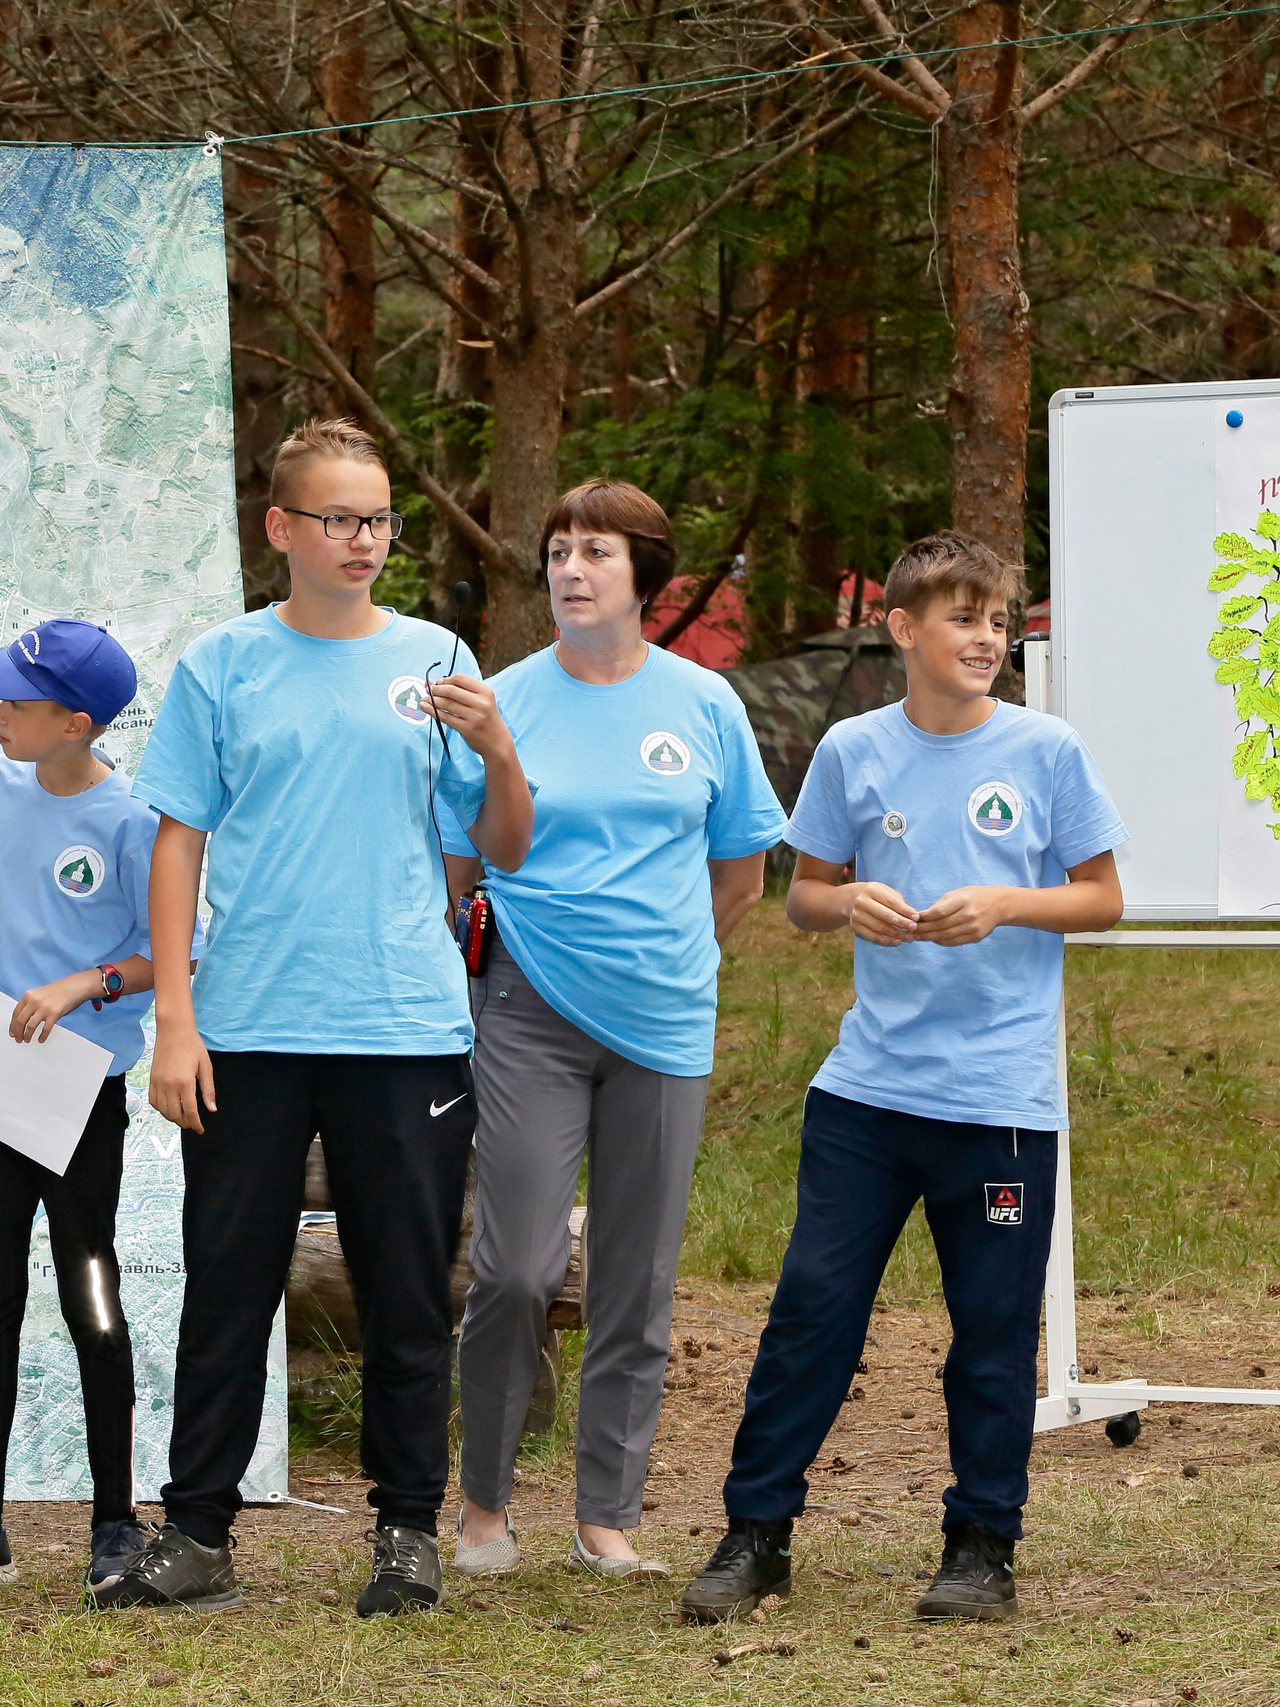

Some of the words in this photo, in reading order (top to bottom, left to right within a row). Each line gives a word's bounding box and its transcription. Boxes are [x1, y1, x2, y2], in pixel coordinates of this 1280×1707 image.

[119, 707, 146, 718] ень
[106, 718, 156, 731] ександ
[989, 1207, 1020, 1221] UFC
